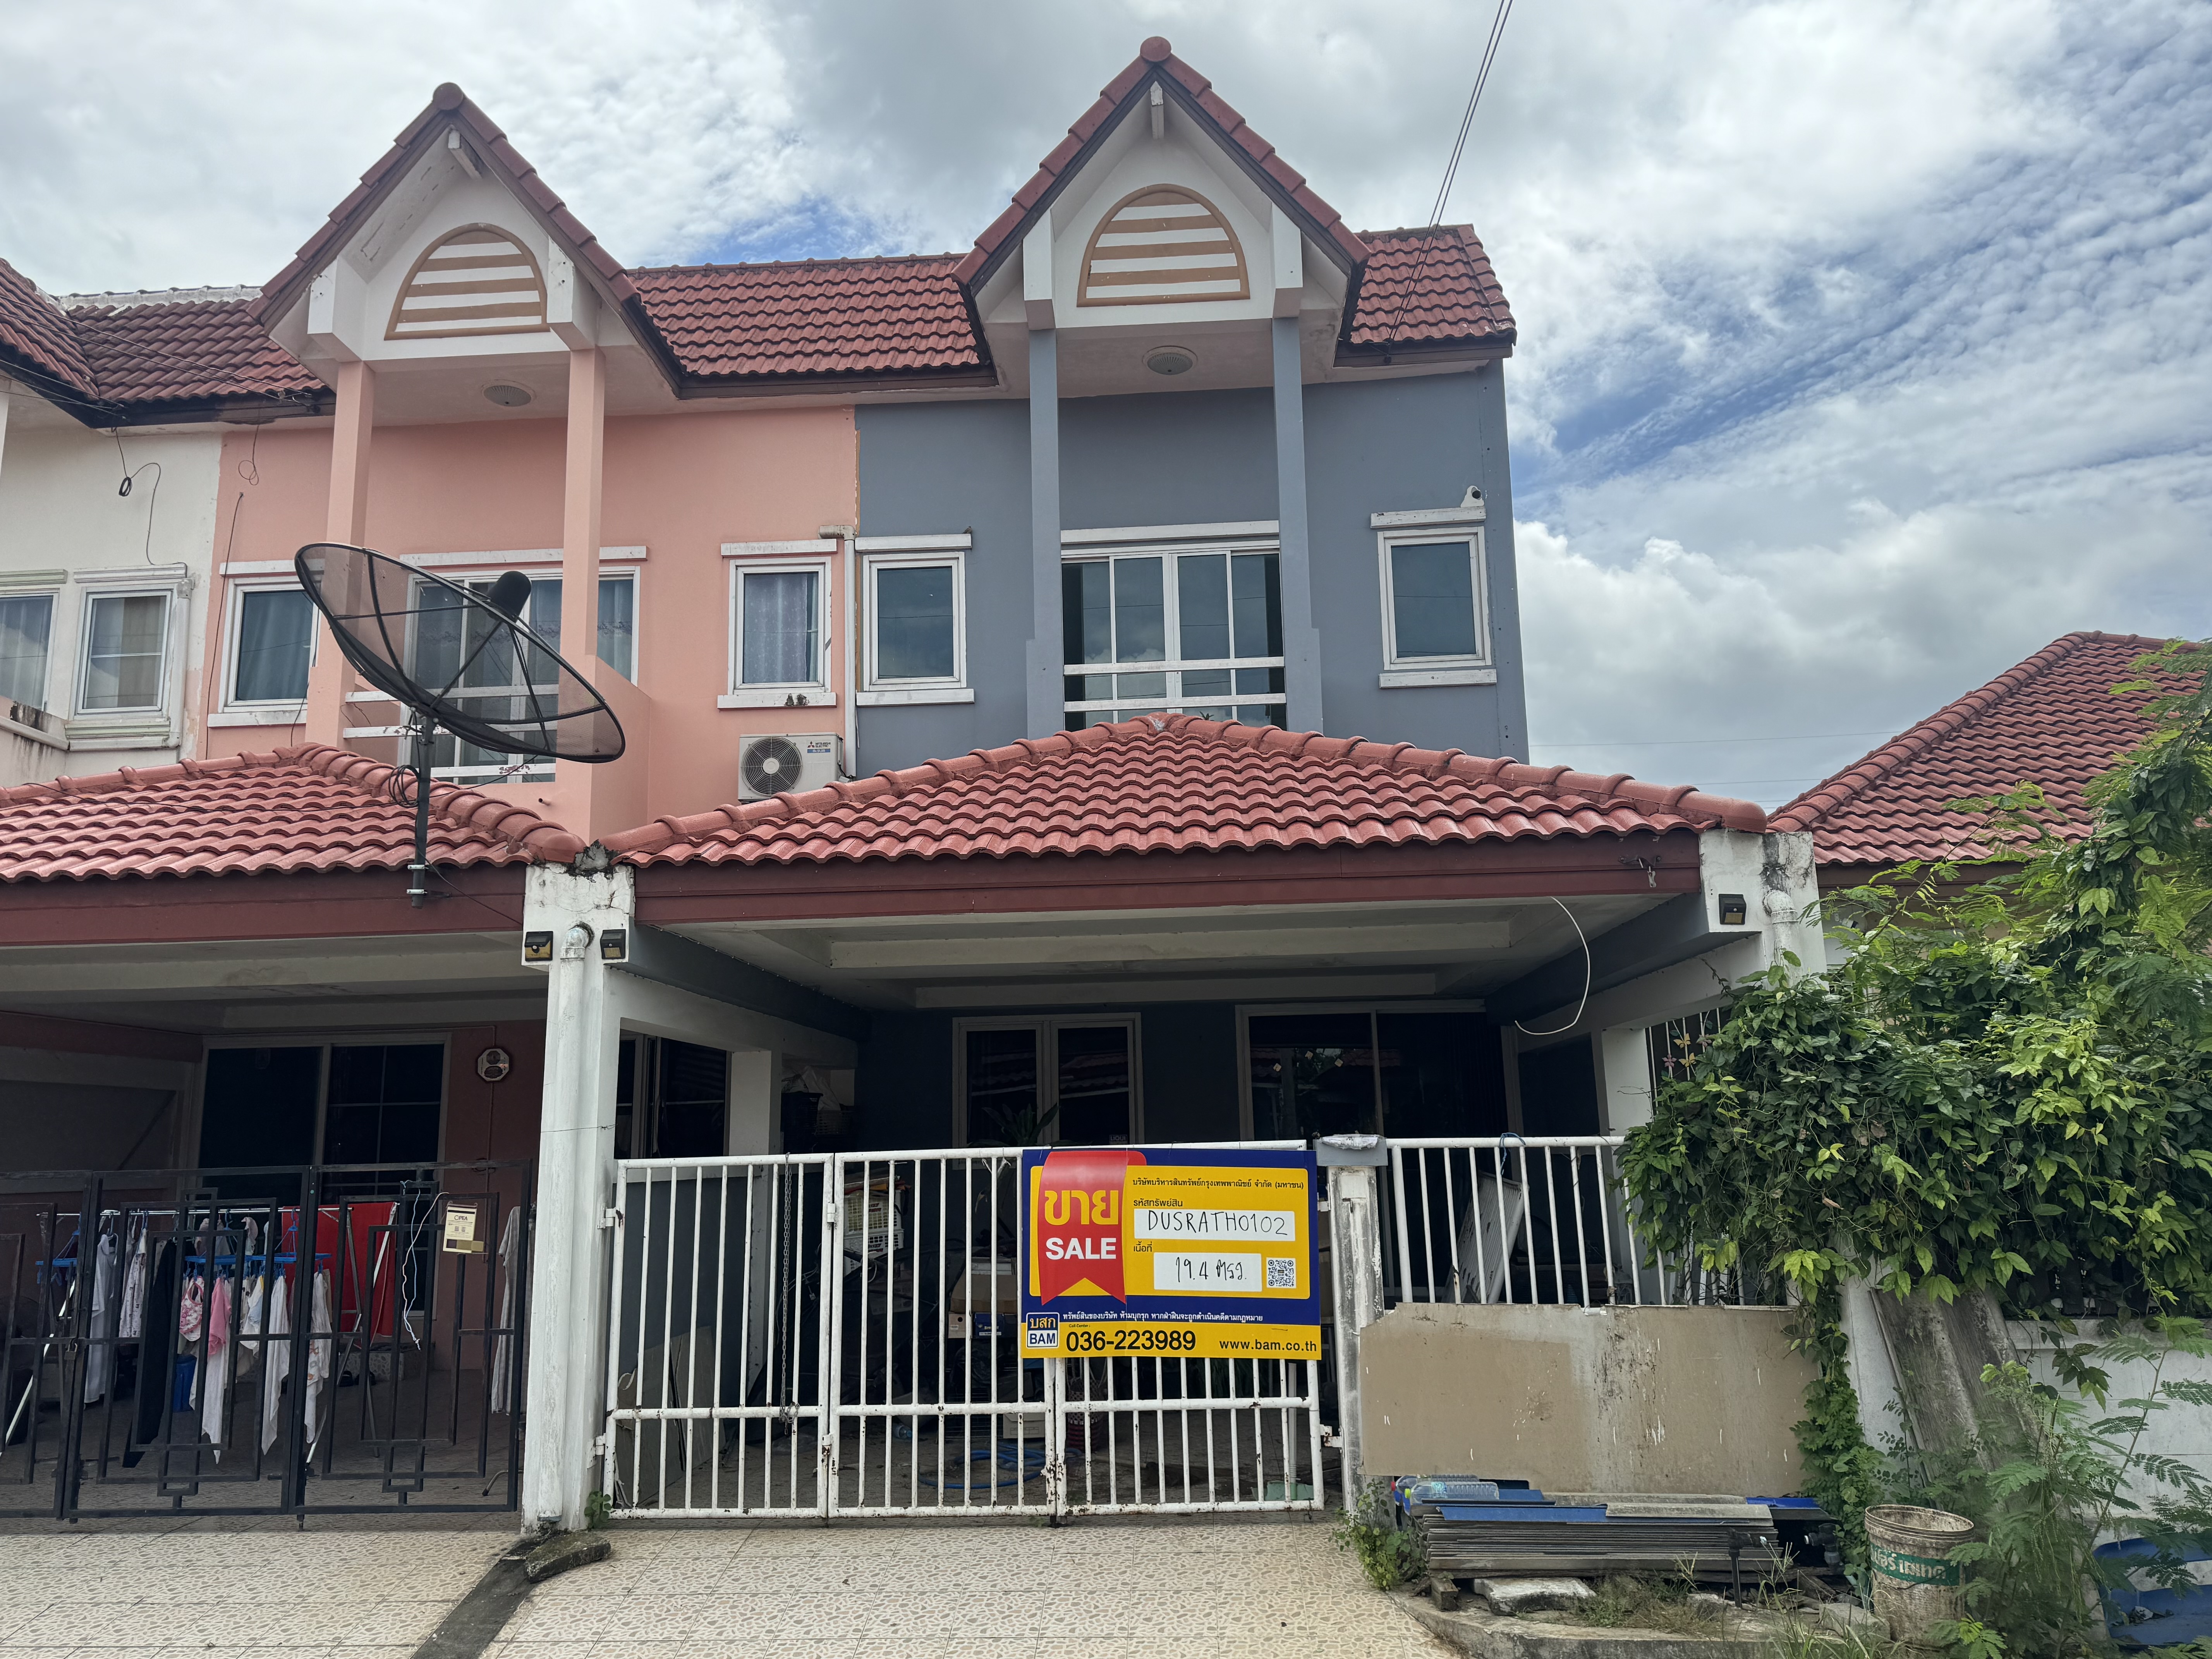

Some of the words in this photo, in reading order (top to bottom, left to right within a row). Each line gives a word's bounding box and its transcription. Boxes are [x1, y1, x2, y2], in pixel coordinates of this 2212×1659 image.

[1133, 1177, 1252, 1189] บริษัทบริหารสินทรัพย์กรุงเทพพาณิชย์
[1254, 1179, 1272, 1188] จำกัด
[1275, 1181, 1304, 1189] (มหาชน)
[1045, 1190, 1119, 1226] ขาย
[1133, 1198, 1183, 1207] รหัสทรัพย์สิน
[1046, 1237, 1116, 1260] SALE
[1133, 1241, 1152, 1252] เนื้อที่
[1063, 1311, 1117, 1320] ทรัพย์สินของบริษัท
[1120, 1310, 1149, 1322] ห้ามบุกรุก
[1030, 1317, 1056, 1329] บสก
[1030, 1333, 1056, 1345] BAM
[1066, 1330, 1196, 1352] 036-223989
[1219, 1339, 1317, 1352] www.bam.co.th
